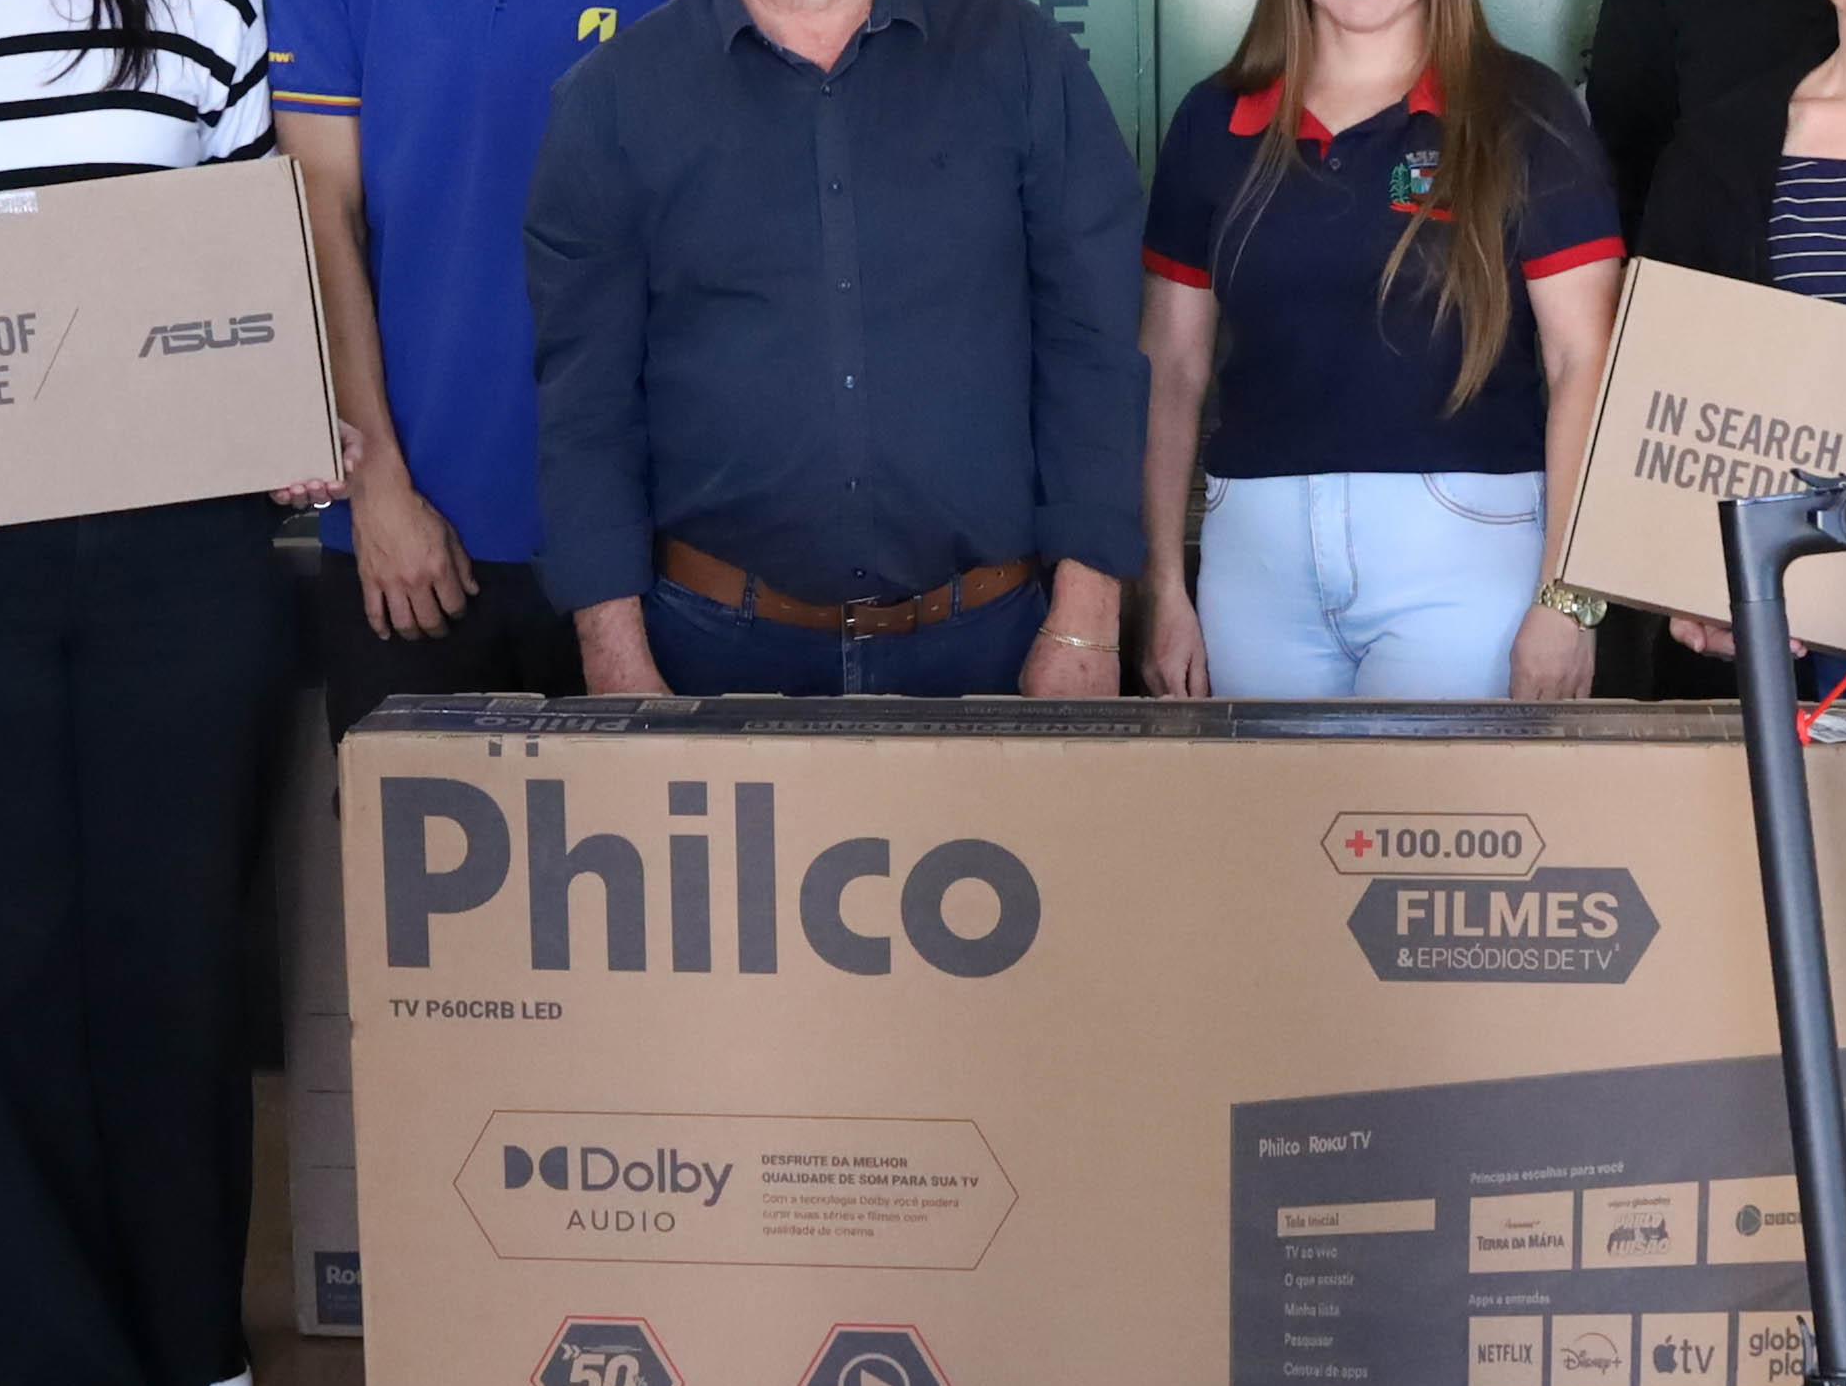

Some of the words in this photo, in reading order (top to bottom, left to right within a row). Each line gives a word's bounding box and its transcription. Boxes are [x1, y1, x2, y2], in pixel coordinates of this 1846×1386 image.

[139, 313, 275, 358] ASUS
[1645, 390, 1688, 436] IN
[1695, 402, 1843, 472] SEARCH
[380, 777, 1041, 979] Philco
[1396, 890, 1619, 938] FILMES
[1417, 943, 1539, 969] EPISÓDIOS
[1544, 949, 1574, 969] DE
[389, 999, 421, 1020] TV
[425, 999, 516, 1021] P60CRB
[521, 1000, 563, 1021] LED
[1258, 1138, 1300, 1158] Philco
[1350, 1131, 1372, 1150] TV
[761, 1154, 828, 1167] DESFRUTE
[831, 1156, 850, 1167] DA
[853, 1156, 908, 1168] MELHOR
[580, 1145, 734, 1208] Dolby
[761, 1171, 836, 1185] QUALIDADE
[838, 1173, 856, 1185] DE
[859, 1174, 889, 1186] SOM
[892, 1175, 927, 1187] PARA
[930, 1175, 957, 1187] SUA
[962, 1176, 979, 1188] TV
[565, 1209, 678, 1234] AUDIO
[1477, 1344, 1533, 1364] NETFLIX
[1682, 1338, 1715, 1374] tv
[1749, 1327, 1801, 1357] glob
